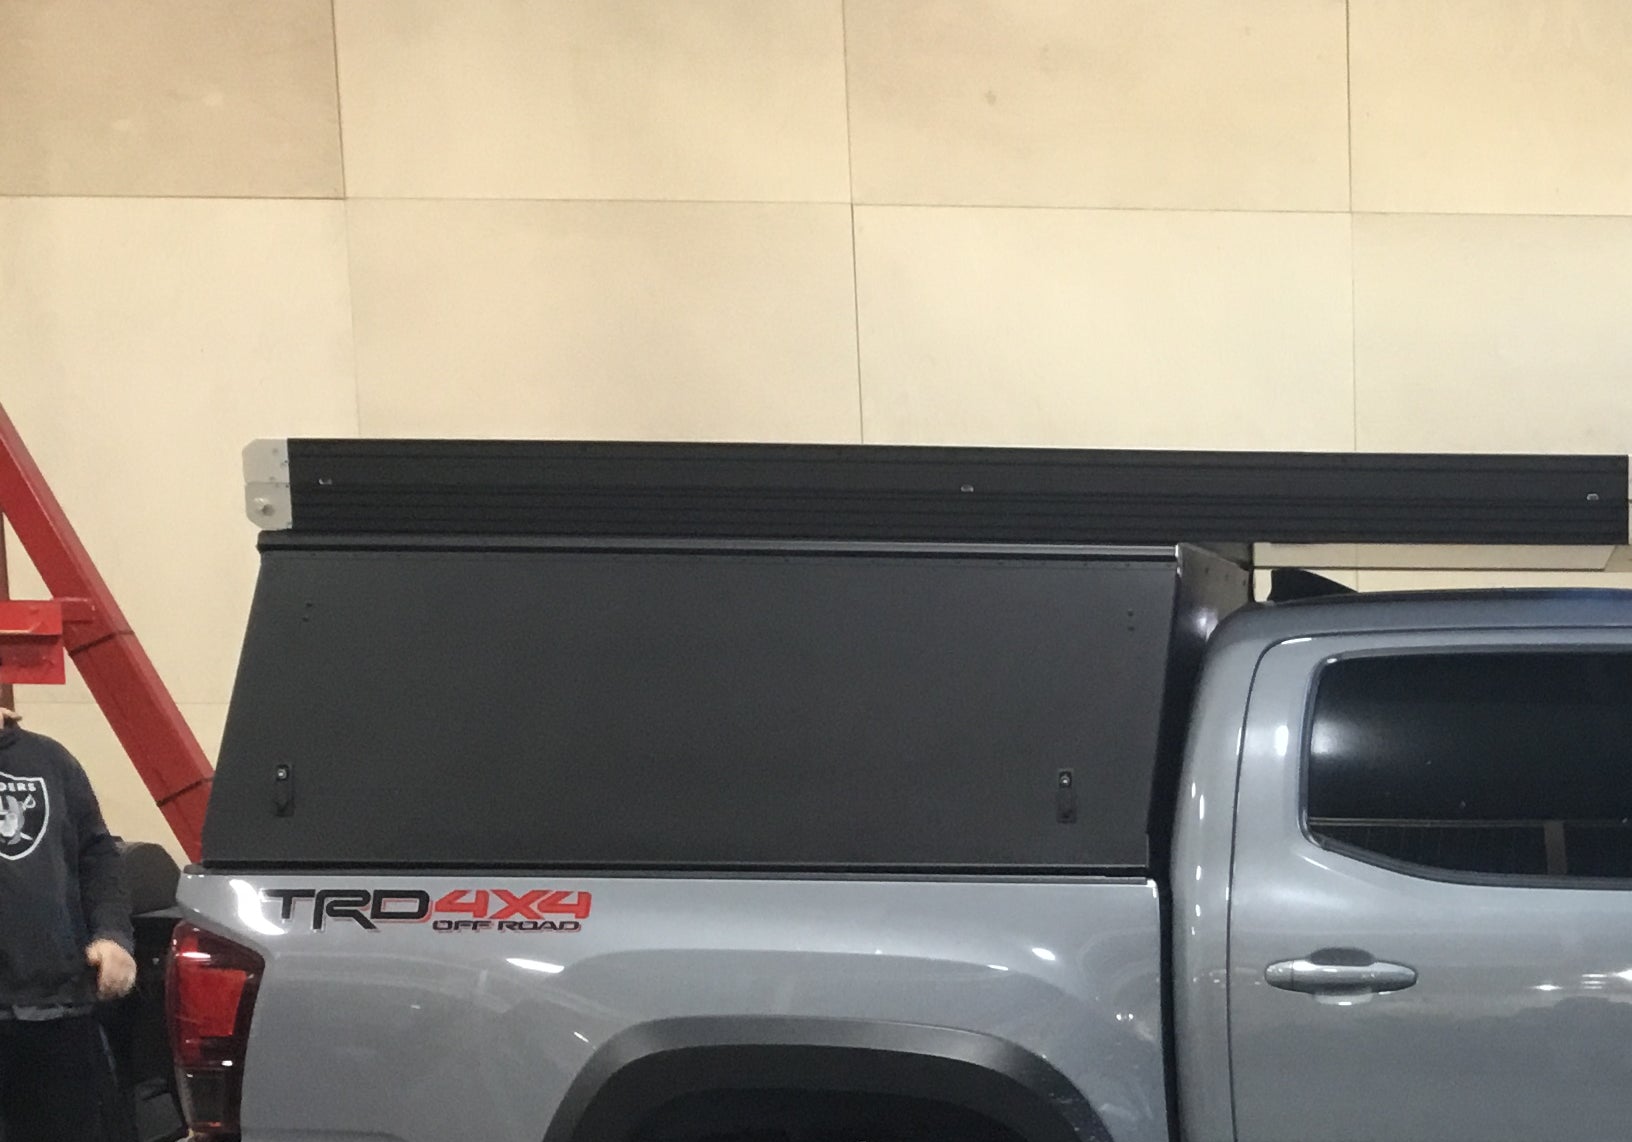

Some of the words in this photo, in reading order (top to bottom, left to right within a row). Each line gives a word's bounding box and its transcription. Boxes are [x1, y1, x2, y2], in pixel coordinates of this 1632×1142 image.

[261, 888, 433, 931] TRD
[432, 919, 493, 932] OFF
[497, 919, 582, 932] ROAD
